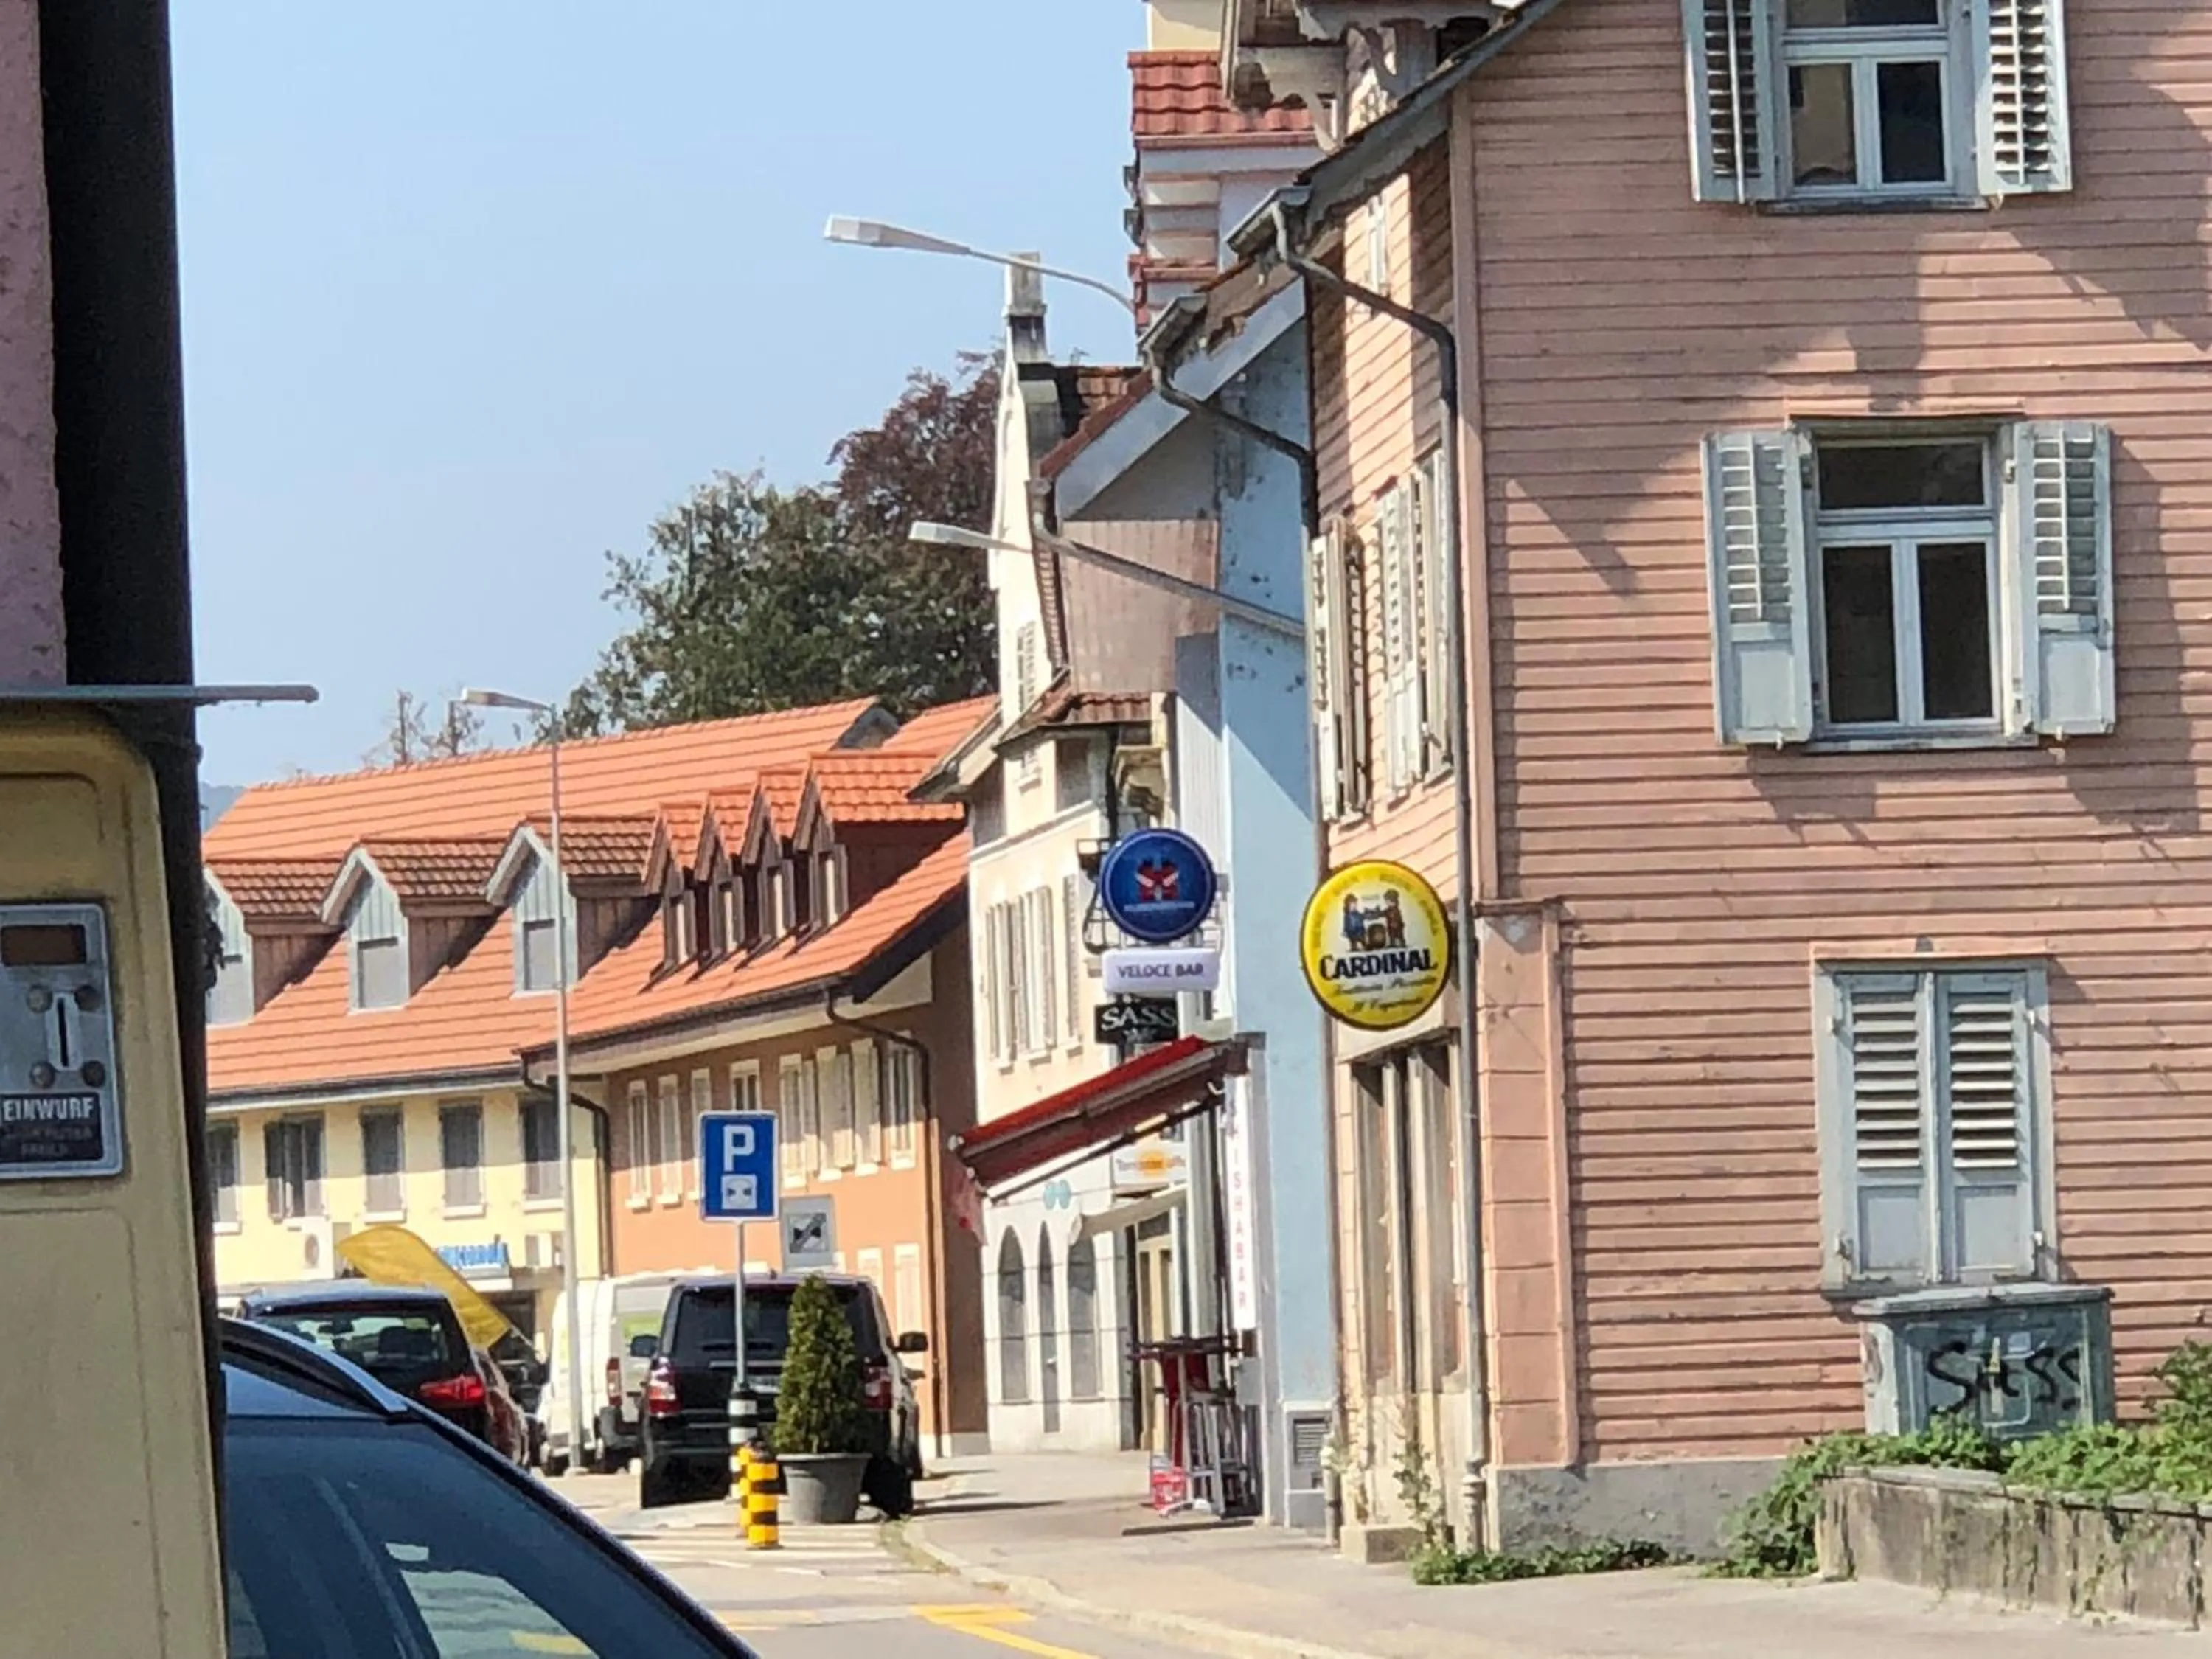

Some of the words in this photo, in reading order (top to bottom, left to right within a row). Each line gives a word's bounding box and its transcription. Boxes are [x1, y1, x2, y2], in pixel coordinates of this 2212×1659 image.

[1117, 964, 1172, 978] VELOCE
[1175, 962, 1204, 977] BAR
[1320, 948, 1439, 981] CARDINAL
[4, 1096, 94, 1121] EINWURF
[723, 1124, 755, 1172] P
